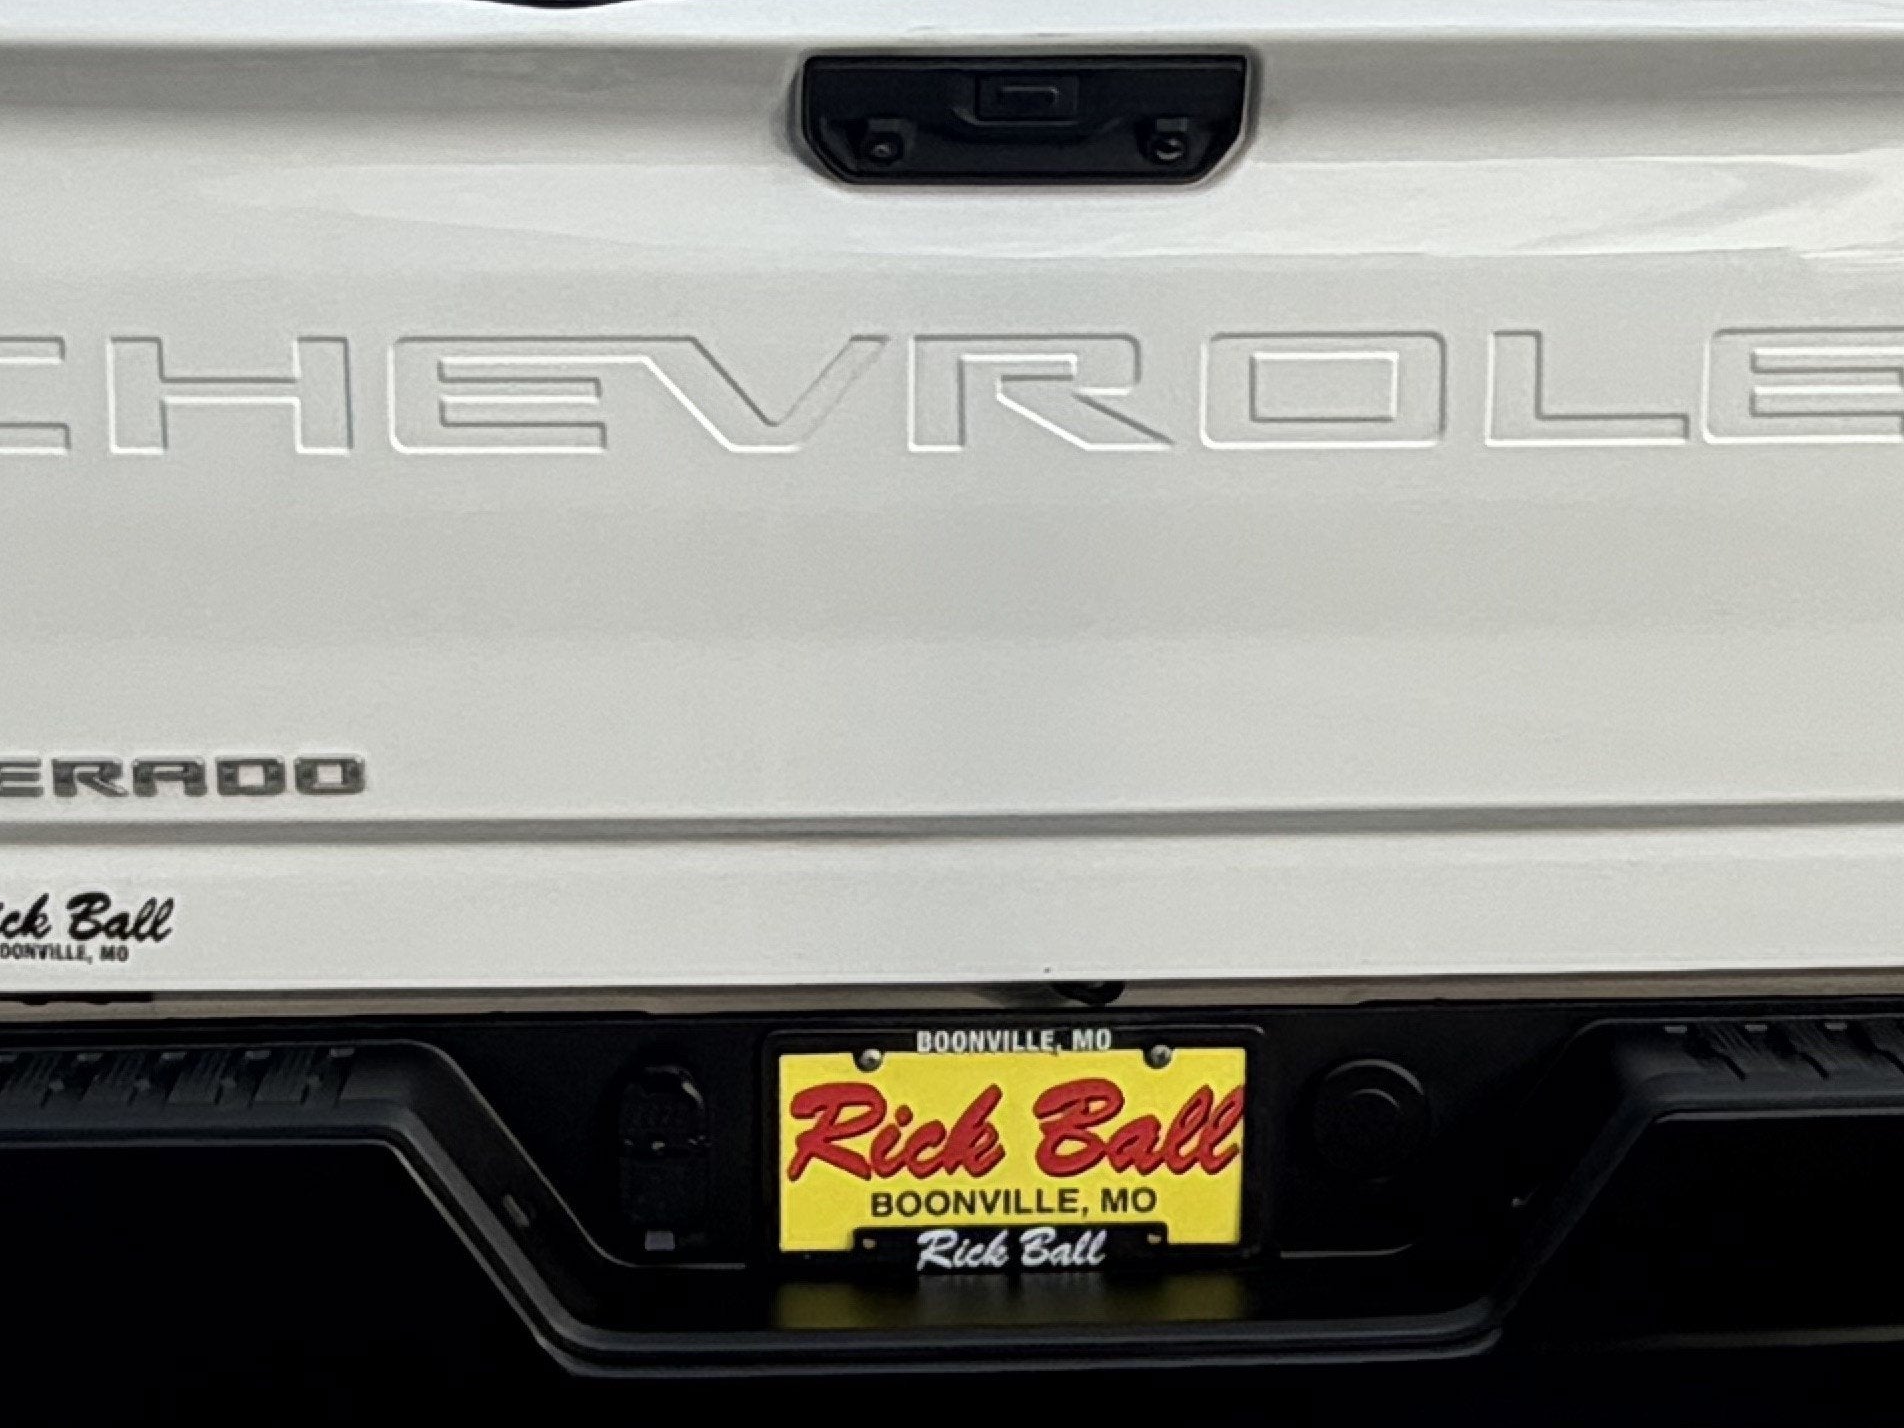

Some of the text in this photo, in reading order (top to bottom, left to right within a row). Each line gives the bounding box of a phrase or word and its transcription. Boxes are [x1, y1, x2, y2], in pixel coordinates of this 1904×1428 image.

[66, 891, 174, 942] Ball
[99, 943, 130, 962] MO
[916, 1028, 1112, 1055] BOONVILLE, MO
[788, 1078, 1245, 1180] Rick Ball
[871, 1186, 1157, 1218] BOONVILLE, MO
[917, 1226, 1107, 1271] Rick Ball
